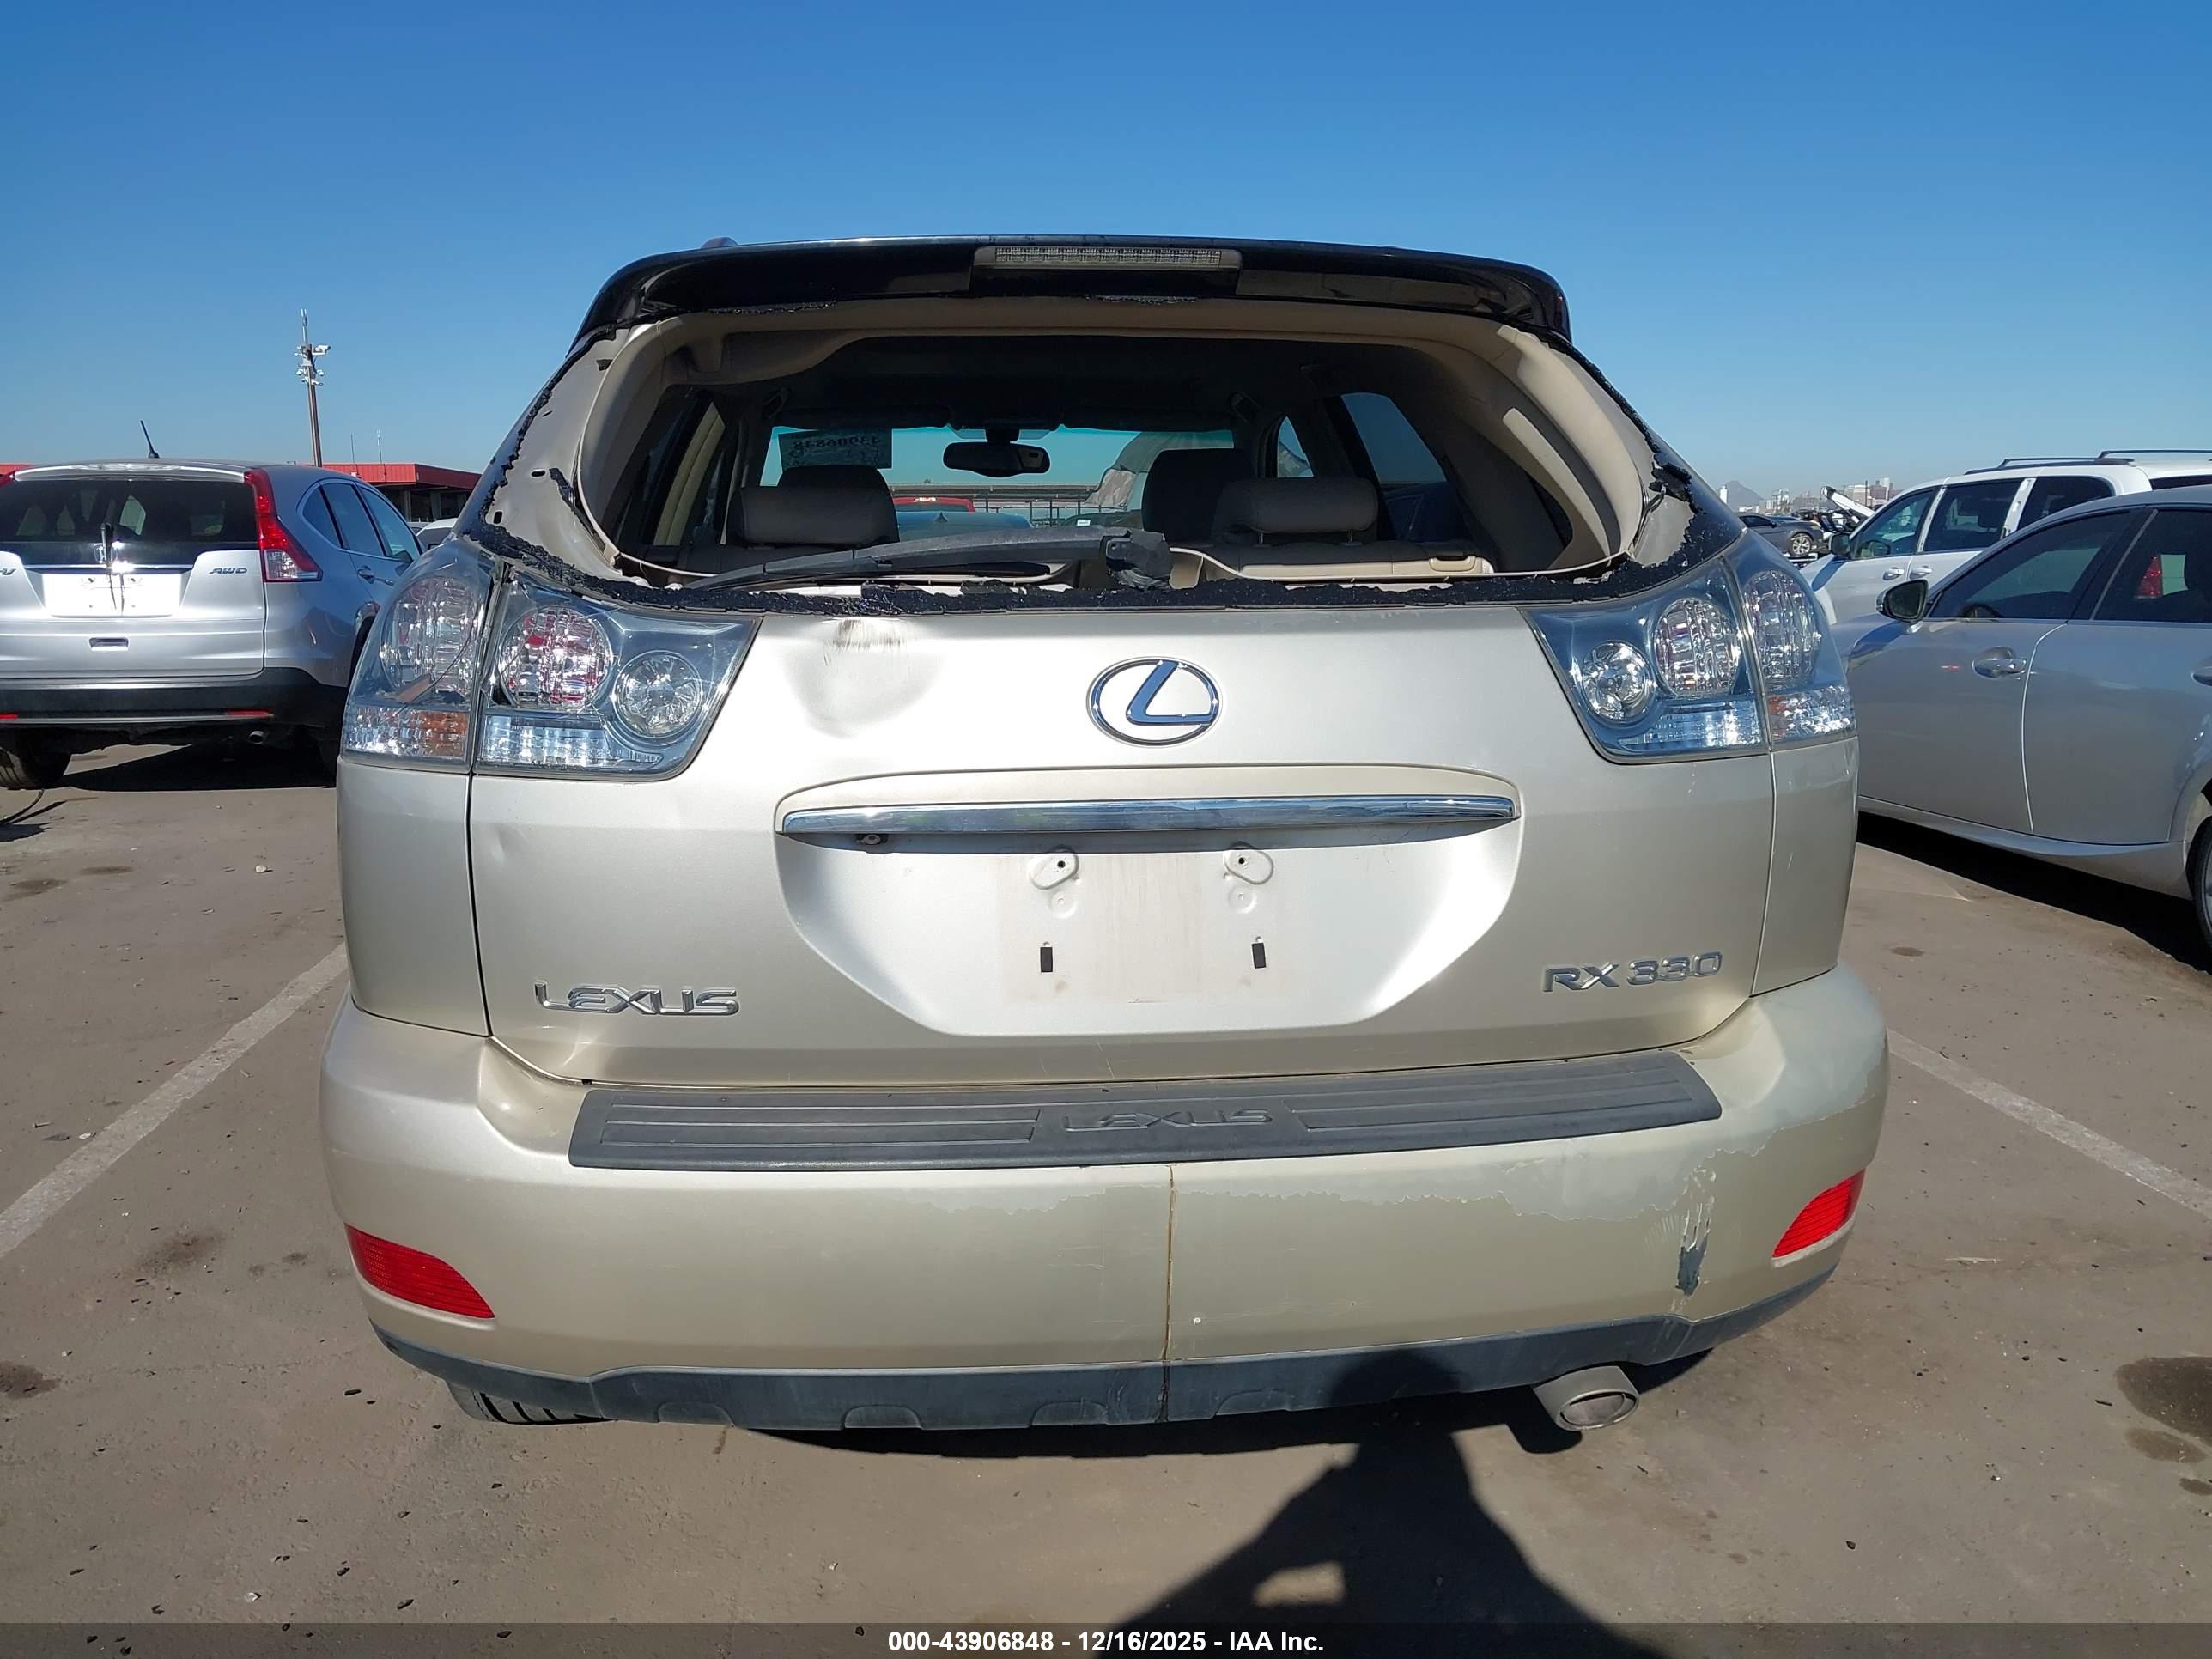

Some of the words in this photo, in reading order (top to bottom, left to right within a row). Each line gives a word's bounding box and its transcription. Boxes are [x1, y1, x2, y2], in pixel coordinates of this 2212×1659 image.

[1543, 962, 1620, 992] RX
[1626, 951, 1723, 986] 330
[534, 980, 739, 1016] LEXUS
[1063, 1109, 1273, 1132] LEXUS
